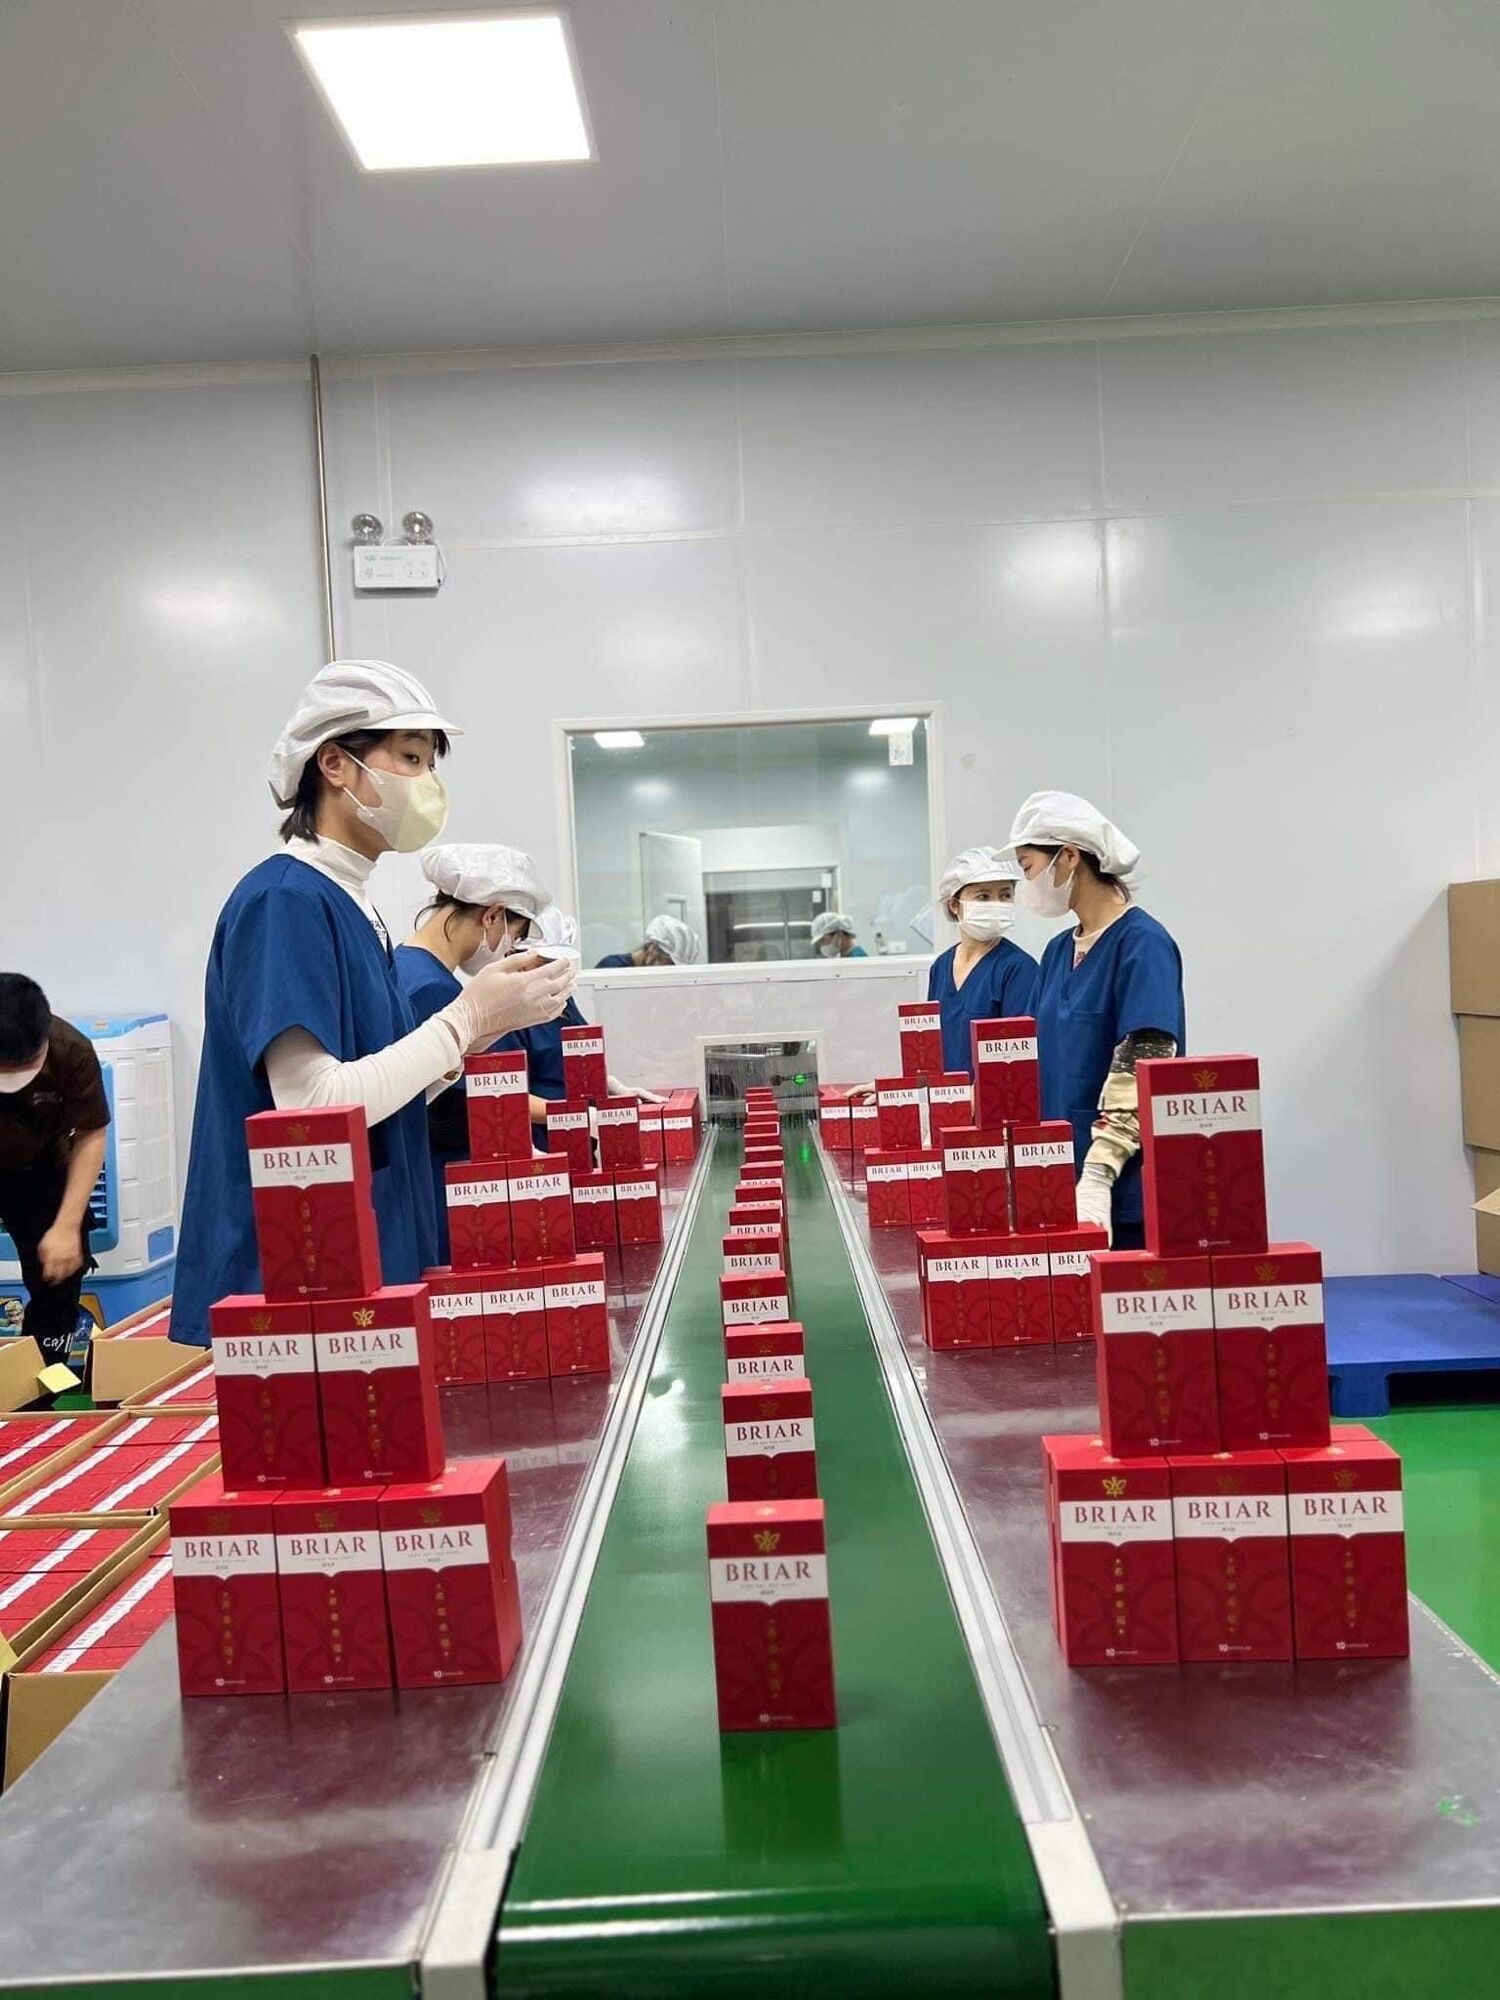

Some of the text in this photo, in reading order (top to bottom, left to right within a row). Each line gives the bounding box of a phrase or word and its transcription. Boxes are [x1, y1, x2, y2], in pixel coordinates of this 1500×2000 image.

[904, 1016, 936, 1025] BRIAR
[566, 1041, 598, 1050] BRIAR
[985, 1040, 1030, 1053] BRIAR
[474, 1074, 519, 1086] BRIAR
[883, 1091, 914, 1100] BRIAR
[934, 1087, 965, 1096] BRIAR
[1166, 1096, 1248, 1117] BRIAR
[551, 1114, 582, 1124] BRIAR
[601, 1110, 632, 1119] BRIAR
[952, 1149, 997, 1161] BRIAR
[1021, 1144, 1066, 1156] BRIAR
[263, 1149, 338, 1170] BRIAR
[871, 1166, 902, 1175] BRIAR
[454, 1182, 500, 1196] BRIAR
[516, 1177, 562, 1191] BRIAR
[620, 1183, 651, 1193] BRIAR
[578, 1188, 609, 1197] BRIAR
[730, 1256, 773, 1268] BRIAR
[935, 1259, 980, 1272] BRIAR
[995, 1257, 1040, 1269] BRIAR
[1058, 1254, 1090, 1265] BRIA
[490, 1291, 535, 1304] BRIAR
[552, 1284, 597, 1298] BRIAR
[731, 1299, 780, 1313] BRIAR
[1116, 1295, 1198, 1315] BRIAR
[1228, 1289, 1310, 1310] BRIAR
[226, 1340, 300, 1358] BRIAR
[329, 1333, 404, 1355] BRIAR
[737, 1358, 795, 1375] BRIAR
[736, 1422, 803, 1441] BRIAR
[1188, 1500, 1272, 1520] BRIAR
[1304, 1496, 1388, 1516] BRIAR
[1075, 1504, 1157, 1524] BRIAR
[291, 1536, 367, 1556] BRIAR
[396, 1530, 473, 1552] BRIAR
[184, 1540, 260, 1558] BRIAR
[726, 1560, 812, 1582] BRIAR
